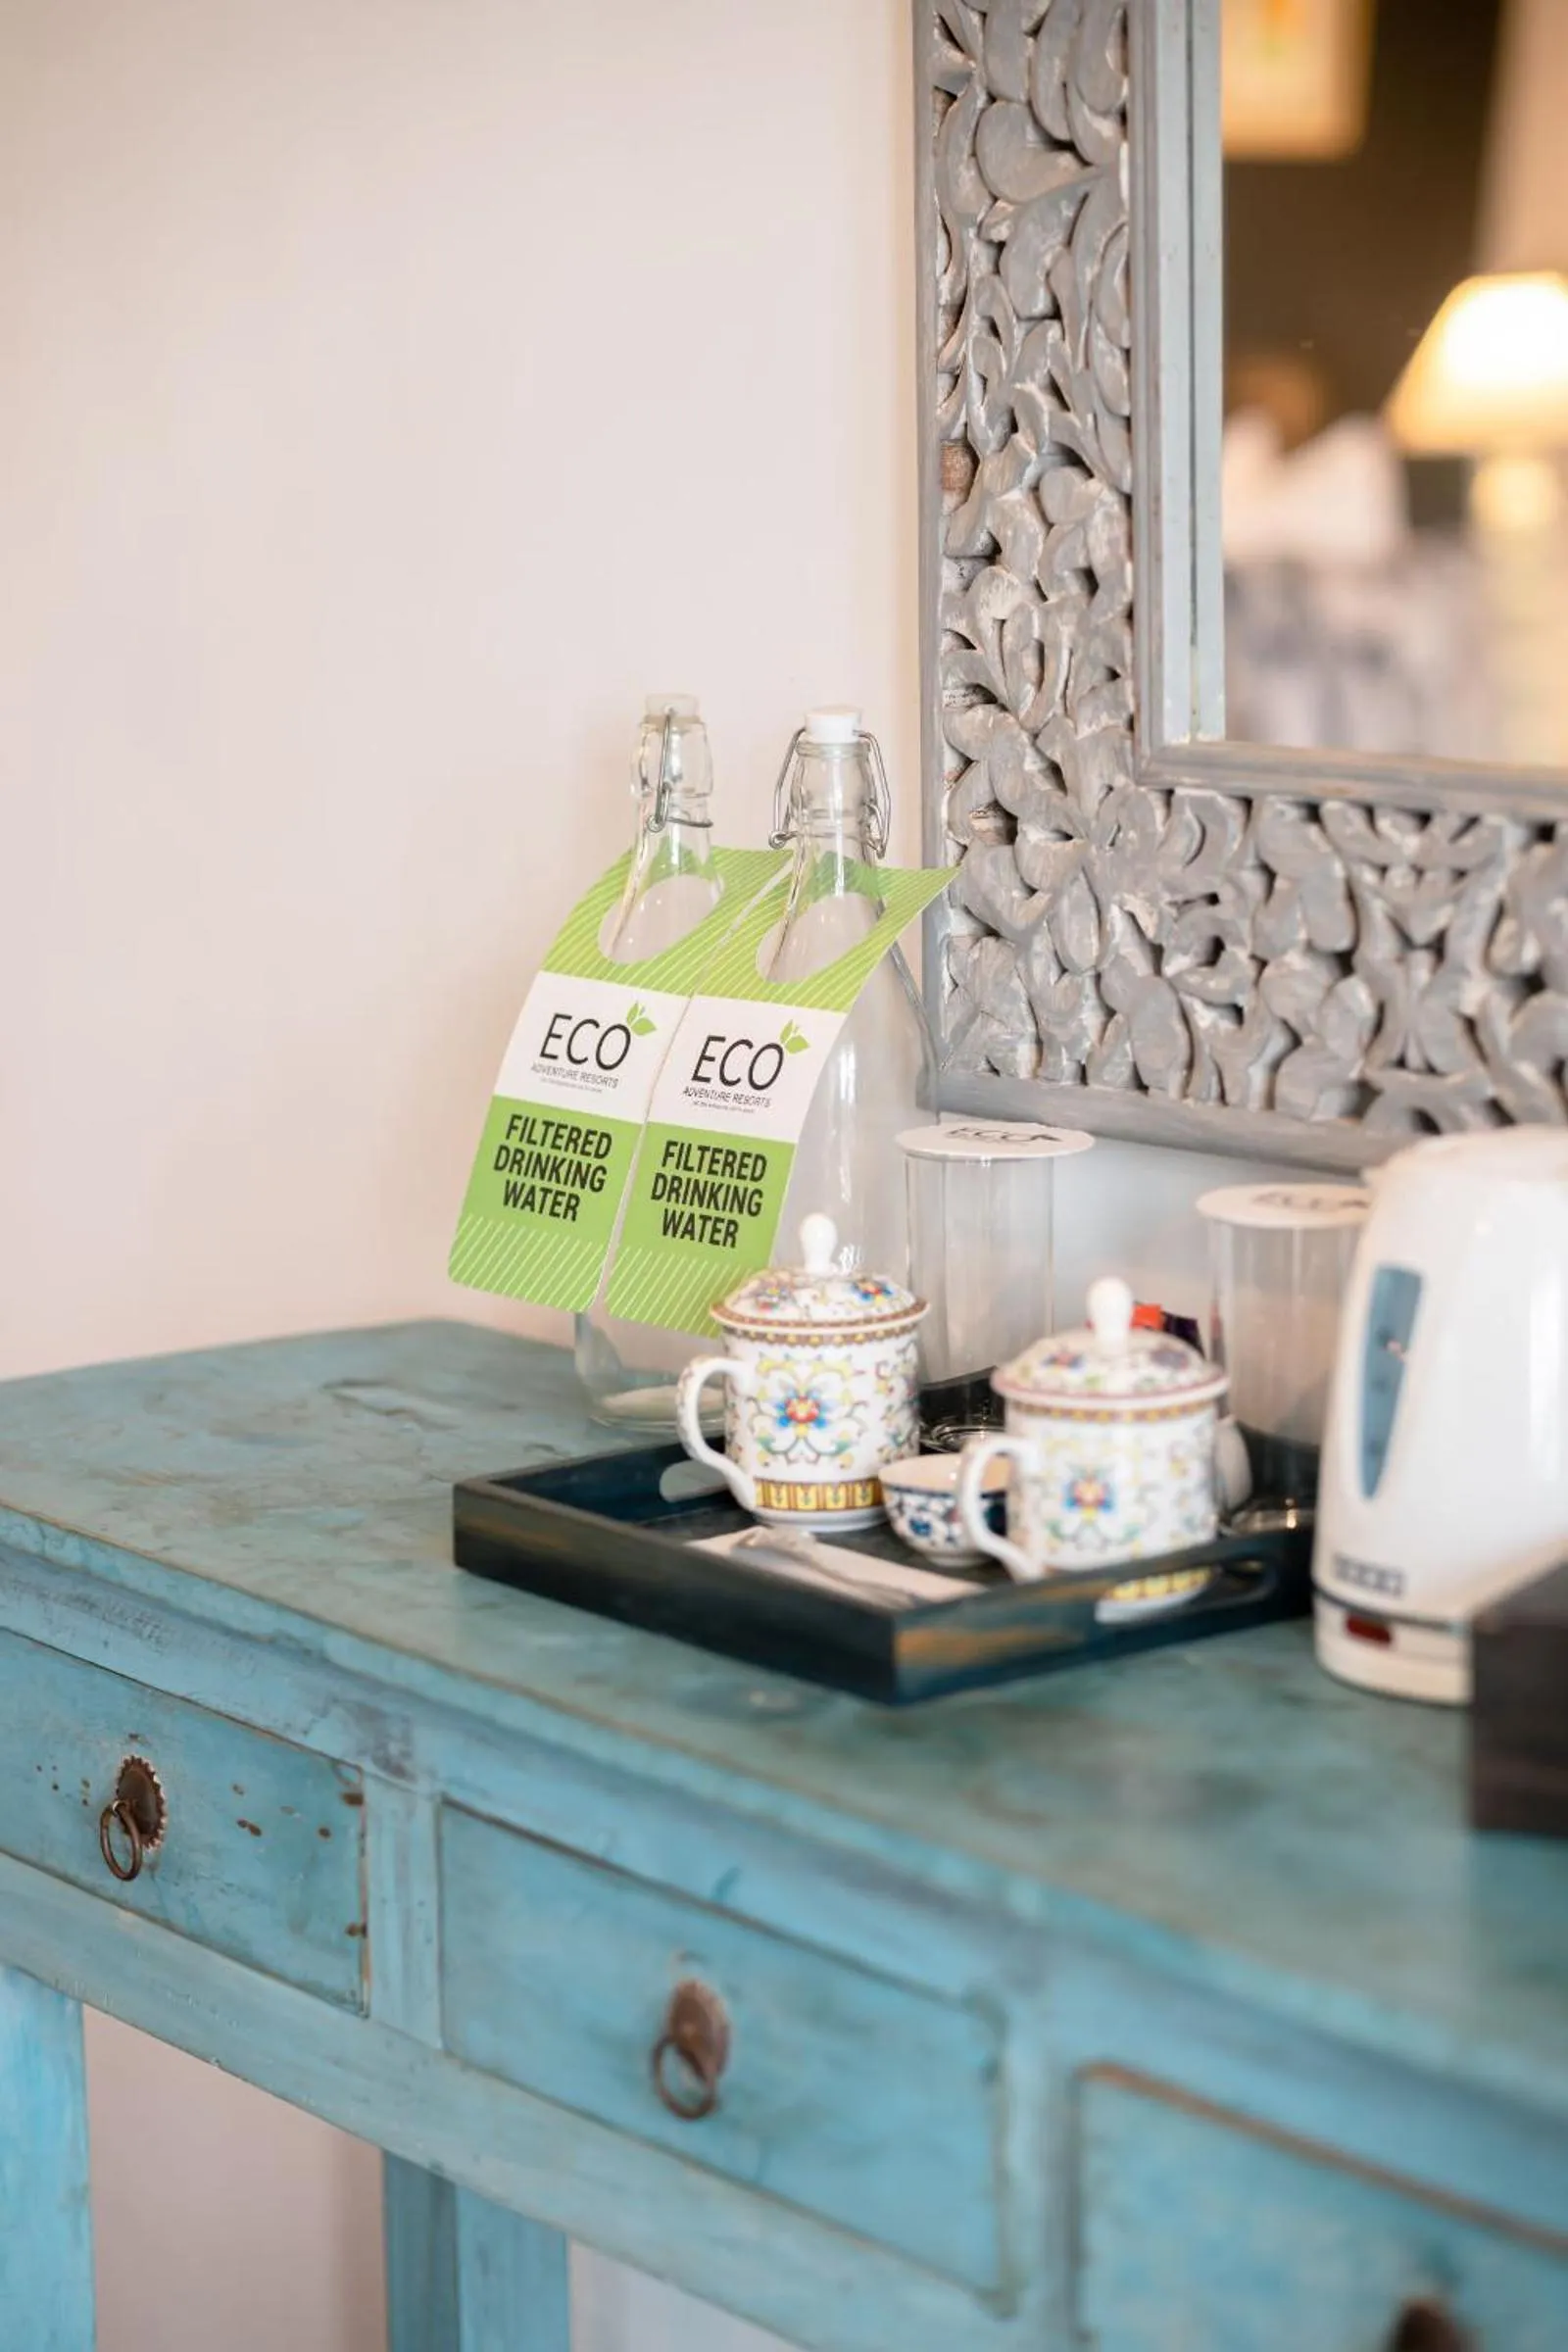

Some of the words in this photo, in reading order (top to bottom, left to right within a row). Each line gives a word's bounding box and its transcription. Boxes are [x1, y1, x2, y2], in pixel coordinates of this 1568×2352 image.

[540, 1012, 632, 1071] ECO
[691, 1035, 784, 1091] ECO
[531, 1063, 579, 1081] ADVENTURE
[580, 1071, 619, 1089] RESORTS
[683, 1086, 731, 1102] ADVENTURE
[731, 1093, 771, 1108] RESORTS
[505, 1113, 612, 1160] FILTERED
[493, 1145, 608, 1193] DRINKING
[662, 1140, 767, 1184] FILTERED
[502, 1180, 581, 1222] WATER
[651, 1172, 763, 1218] DRINKING
[662, 1208, 740, 1250] WATER
